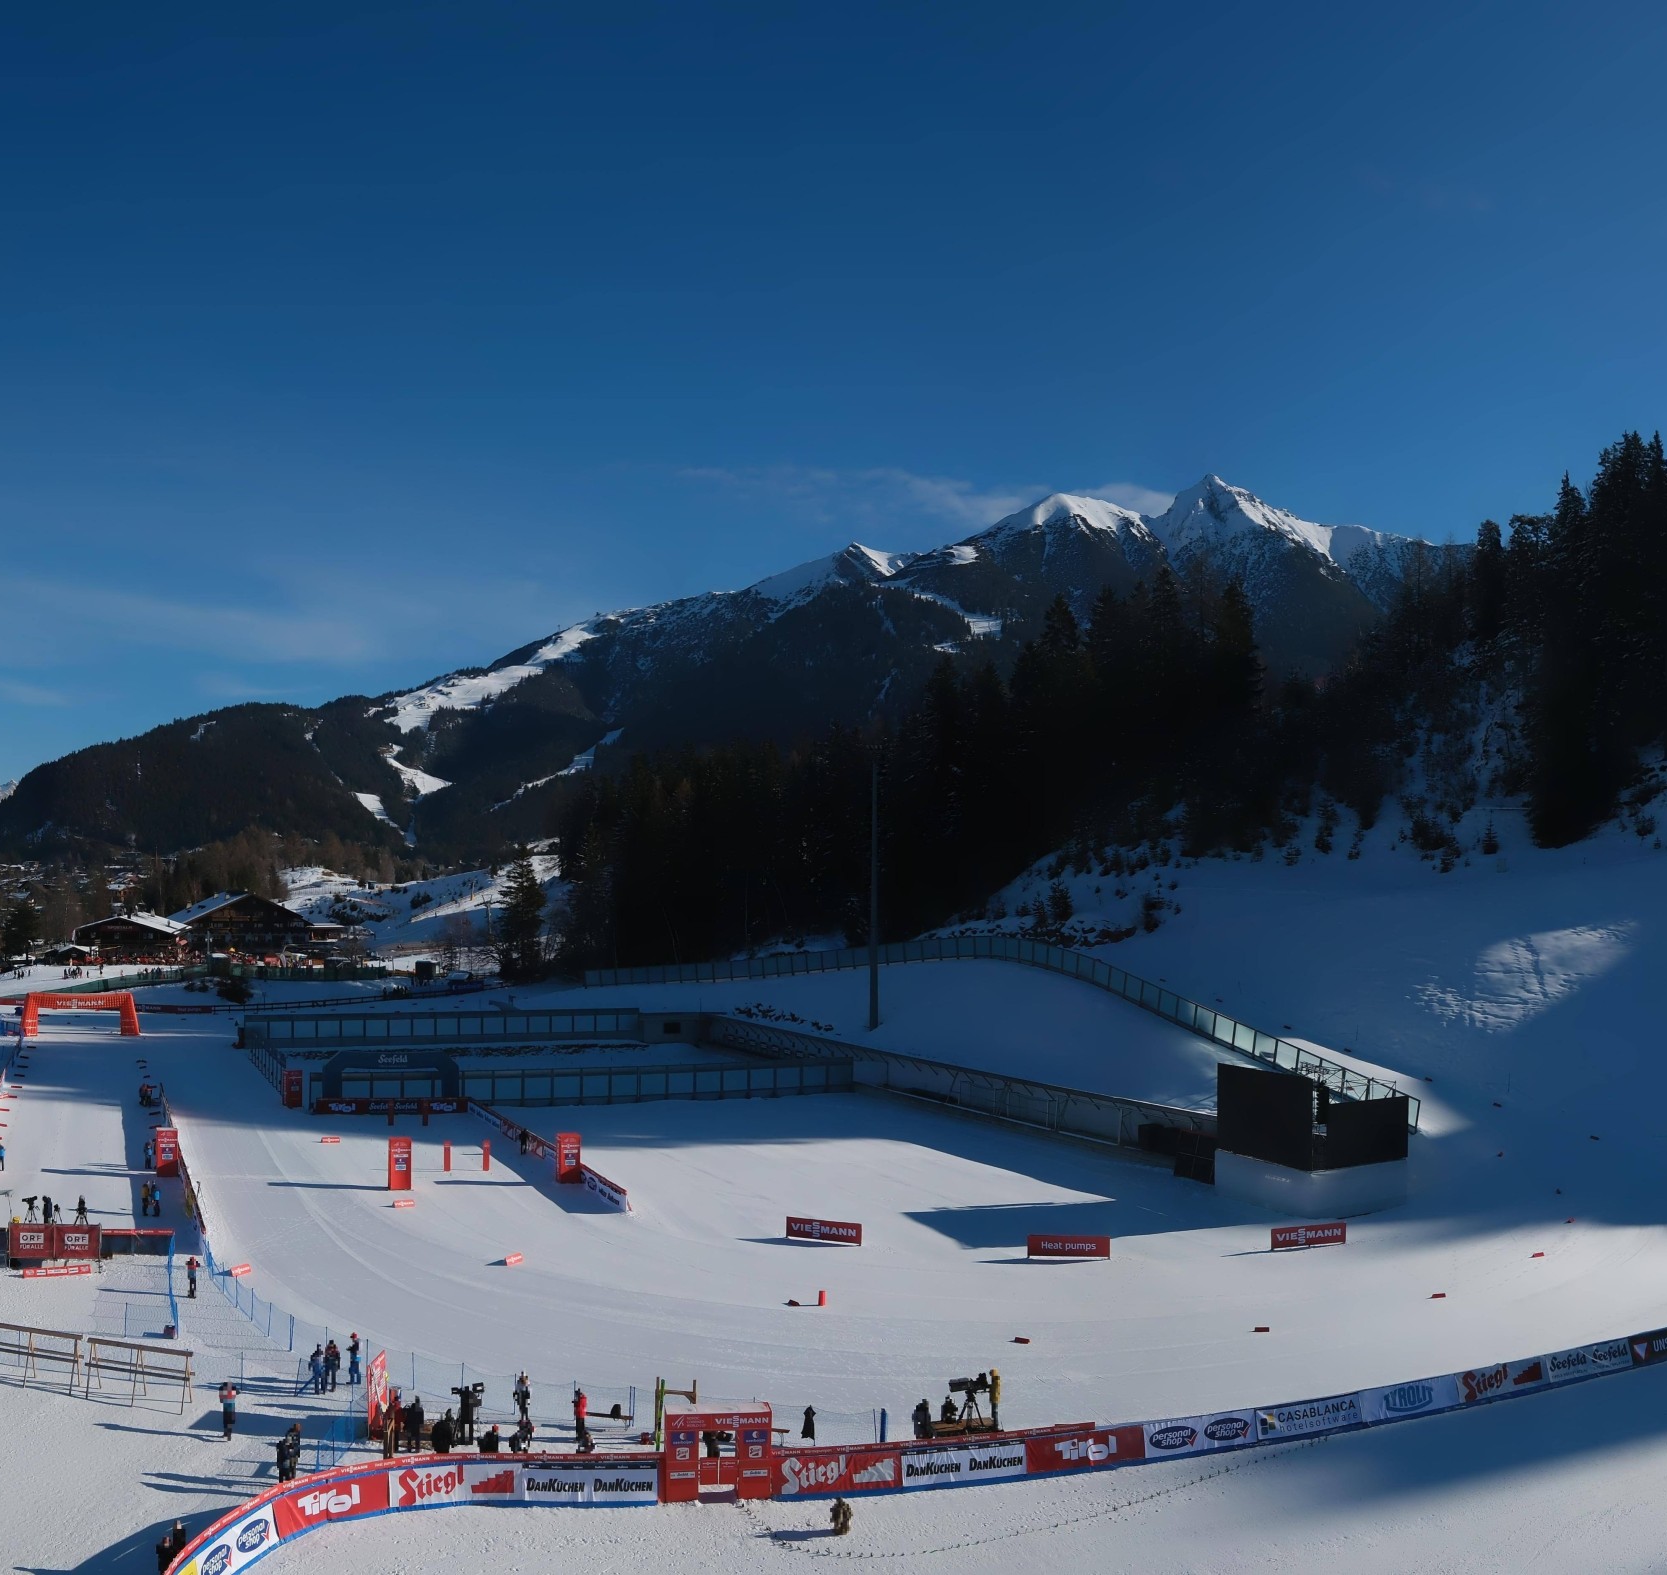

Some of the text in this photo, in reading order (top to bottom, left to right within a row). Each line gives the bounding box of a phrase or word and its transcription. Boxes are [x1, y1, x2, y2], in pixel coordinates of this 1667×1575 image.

[56, 998, 104, 1009] VIESSMANN
[378, 1053, 408, 1065] Seefeld
[393, 1101, 417, 1113] Seefeld
[791, 1221, 857, 1238] VIESSMANN
[1276, 1227, 1342, 1245] VIESSMANN
[1041, 1241, 1097, 1253] Heat pumps
[1549, 1353, 1587, 1373] Seefeld
[1591, 1343, 1628, 1363] Seefeld
[1461, 1363, 1508, 1403] Stiegl
[1383, 1384, 1433, 1408] TYROLIT
[715, 1415, 769, 1428] VIESSMANN
[1278, 1399, 1356, 1424] CASABLANCA
[1206, 1419, 1245, 1435] personal
[1279, 1411, 1358, 1433] hotelsoftware
[771, 1448, 800, 1456] VIESSMANN
[836, 1444, 865, 1453] VIESSMANN
[900, 1440, 928, 1448] VIESSMANN
[962, 1434, 990, 1442] VIESSMANN
[1023, 1428, 1051, 1436] VIESSMANN
[1152, 1428, 1191, 1442] personal
[1161, 1436, 1182, 1448] shop
[1215, 1427, 1236, 1439] shop
[1054, 1435, 1117, 1460] Tirol
[282, 1477, 309, 1489] VIESSMANN
[341, 1464, 368, 1474] VIESSMANN
[401, 1455, 430, 1465] VIESSMANN
[466, 1453, 496, 1462] VIESSMANN
[534, 1453, 564, 1462] VIESSMANN
[600, 1452, 630, 1461] VIESSMANN
[781, 1455, 847, 1495] Stiegl
[398, 1464, 465, 1506] Stiegl
[297, 1484, 360, 1516] Tirol
[237, 1519, 266, 1546] personal
[245, 1534, 260, 1550] shop
[202, 1545, 228, 1574] personal
[209, 1558, 224, 1575] shop
